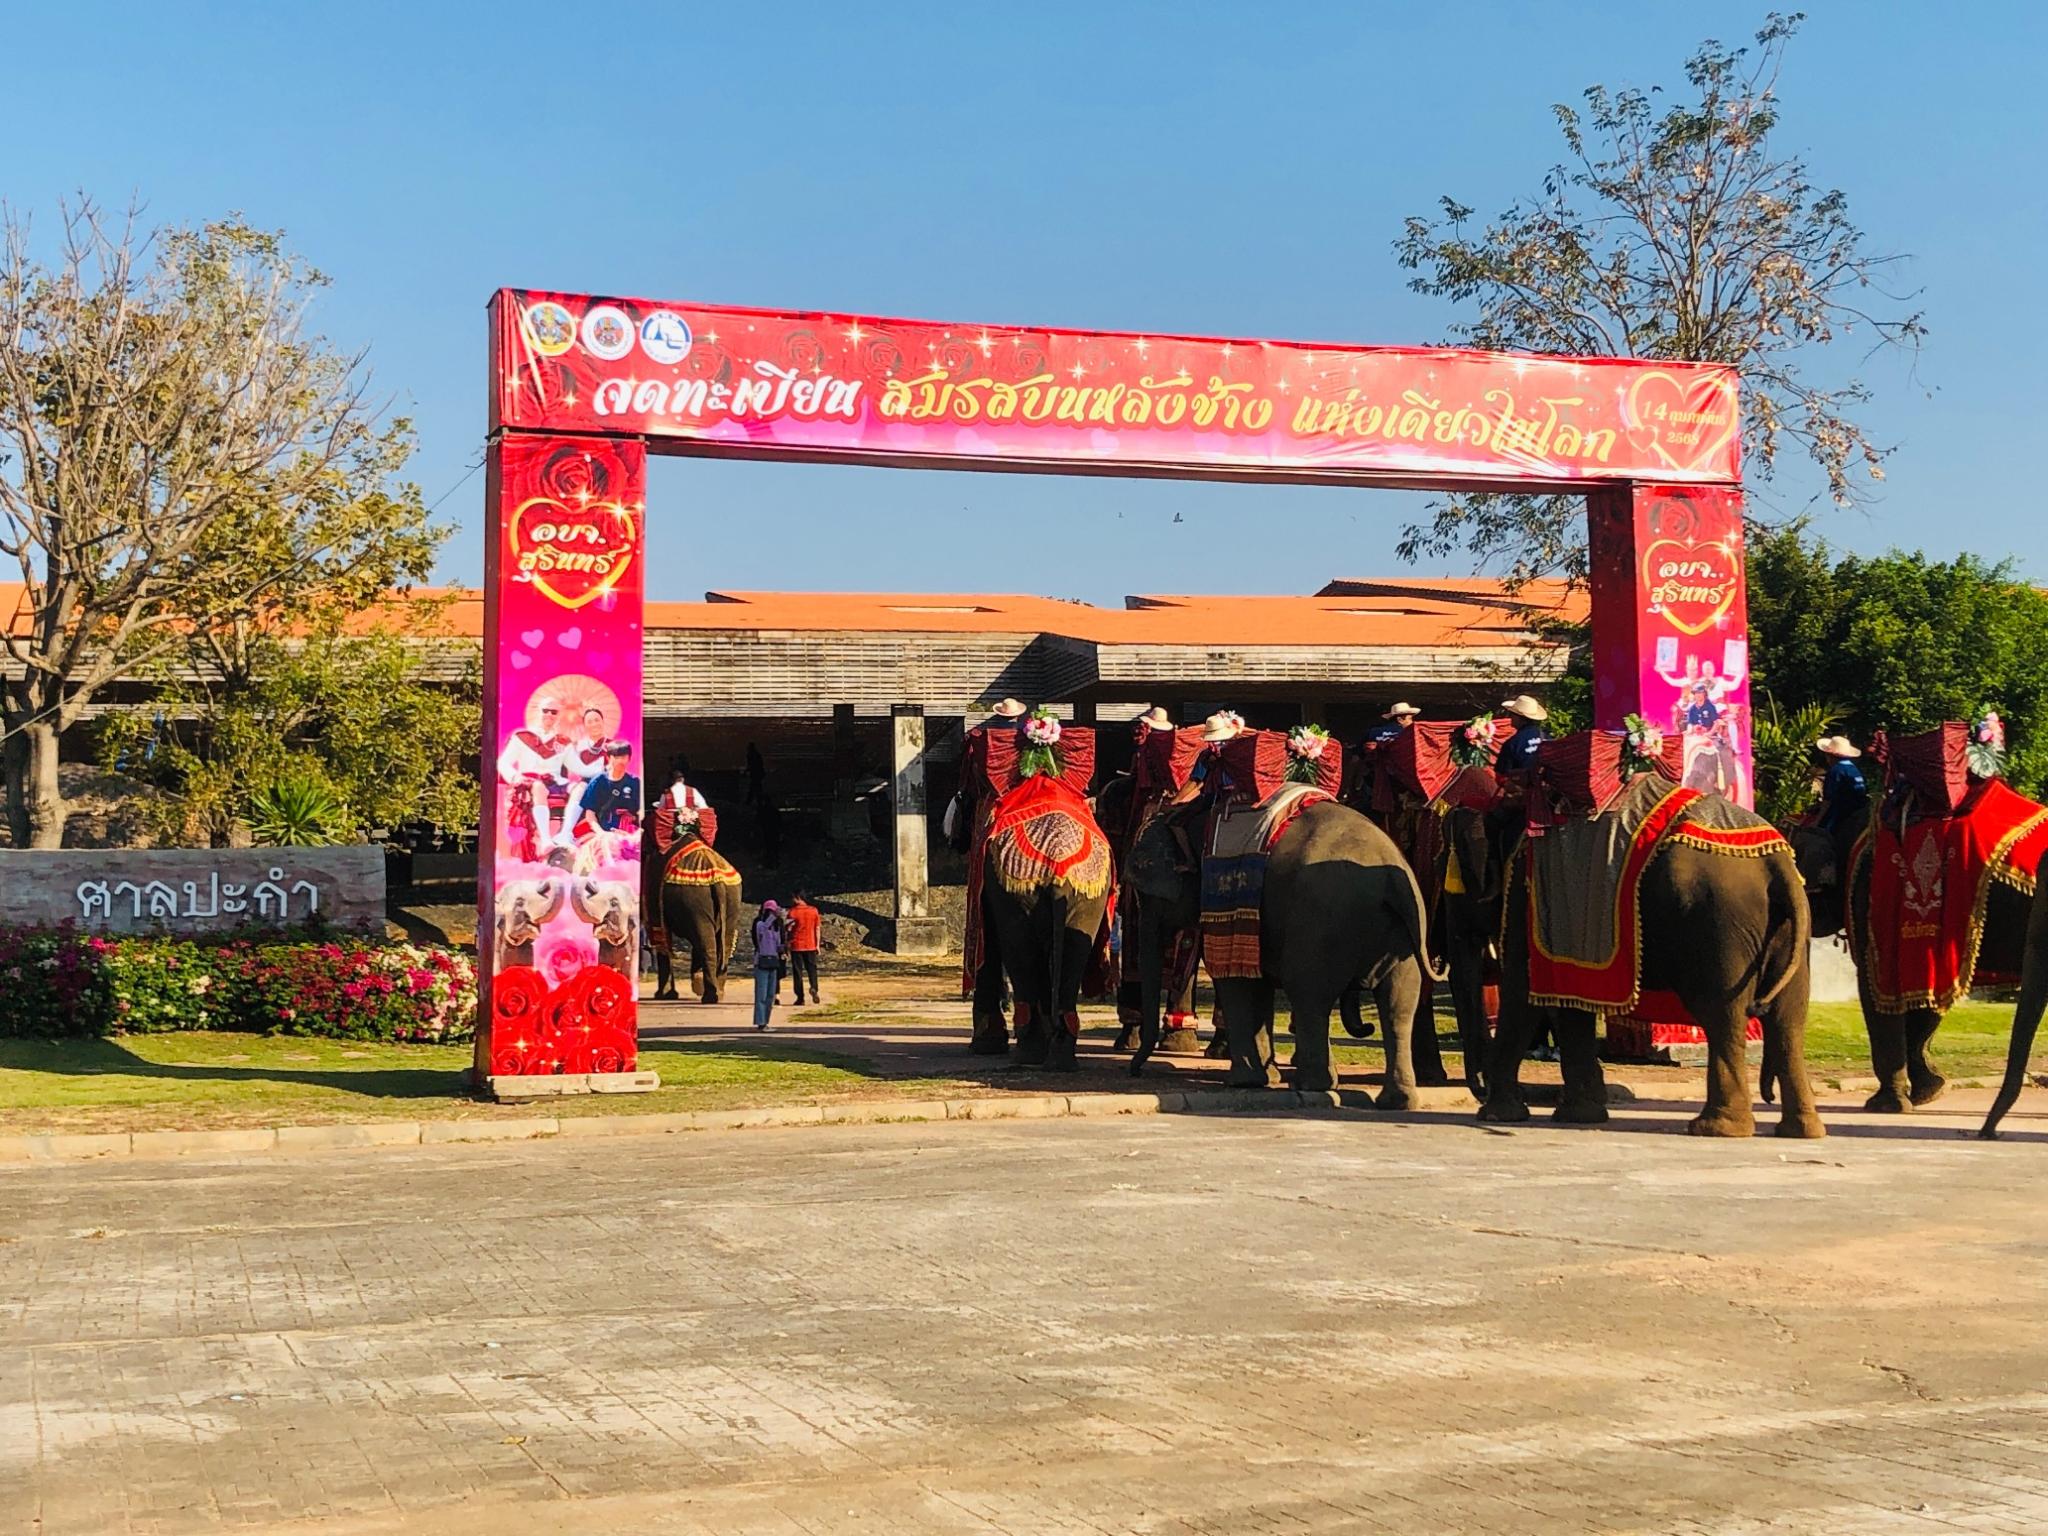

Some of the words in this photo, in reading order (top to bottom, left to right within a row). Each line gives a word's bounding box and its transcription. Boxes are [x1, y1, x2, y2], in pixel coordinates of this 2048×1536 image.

[592, 360, 863, 416] จดทะเบียน
[879, 371, 1273, 430] สมรสบนหลังช้าง
[1291, 389, 1617, 462] แห่งเดียวในโลก
[1643, 400, 1668, 420] 14
[530, 523, 606, 544] อบจ.
[511, 543, 631, 583] สุรินทร์
[1658, 561, 1717, 579] อบจ.
[1646, 578, 1736, 613] สุรินทร์
[76, 867, 318, 918] ศาลปะกำ
